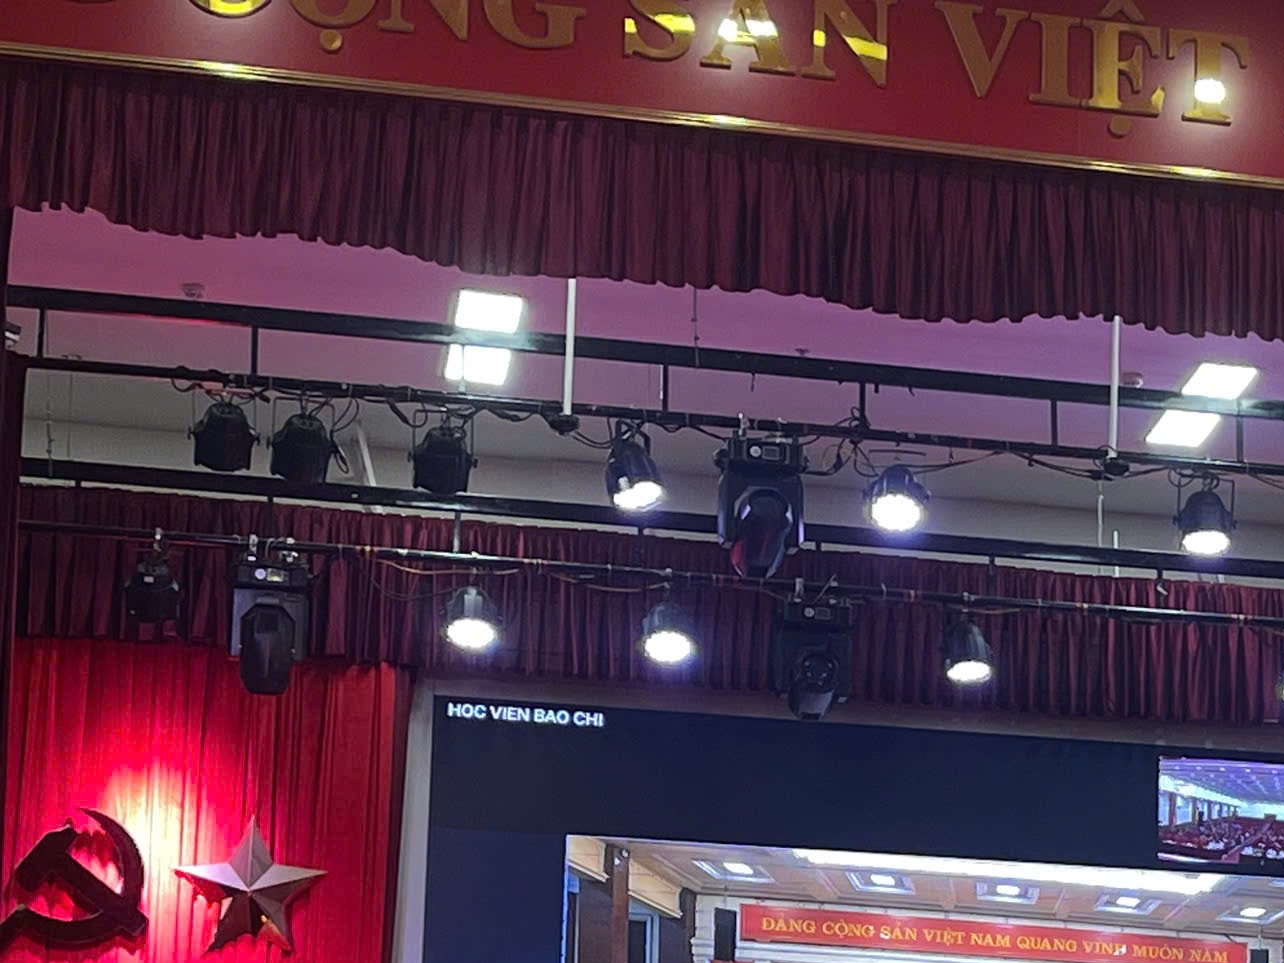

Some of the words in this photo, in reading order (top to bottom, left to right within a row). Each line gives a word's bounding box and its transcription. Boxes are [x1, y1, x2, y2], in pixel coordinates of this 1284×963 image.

[934, 0, 1249, 137] VIỆT
[447, 702, 486, 719] HOC
[489, 705, 530, 722] VIEN
[533, 708, 570, 725] BAO
[573, 711, 604, 728] CHI
[970, 932, 1011, 948] NAM
[1016, 936, 1077, 953] QUANG
[1082, 940, 1127, 956] VINH
